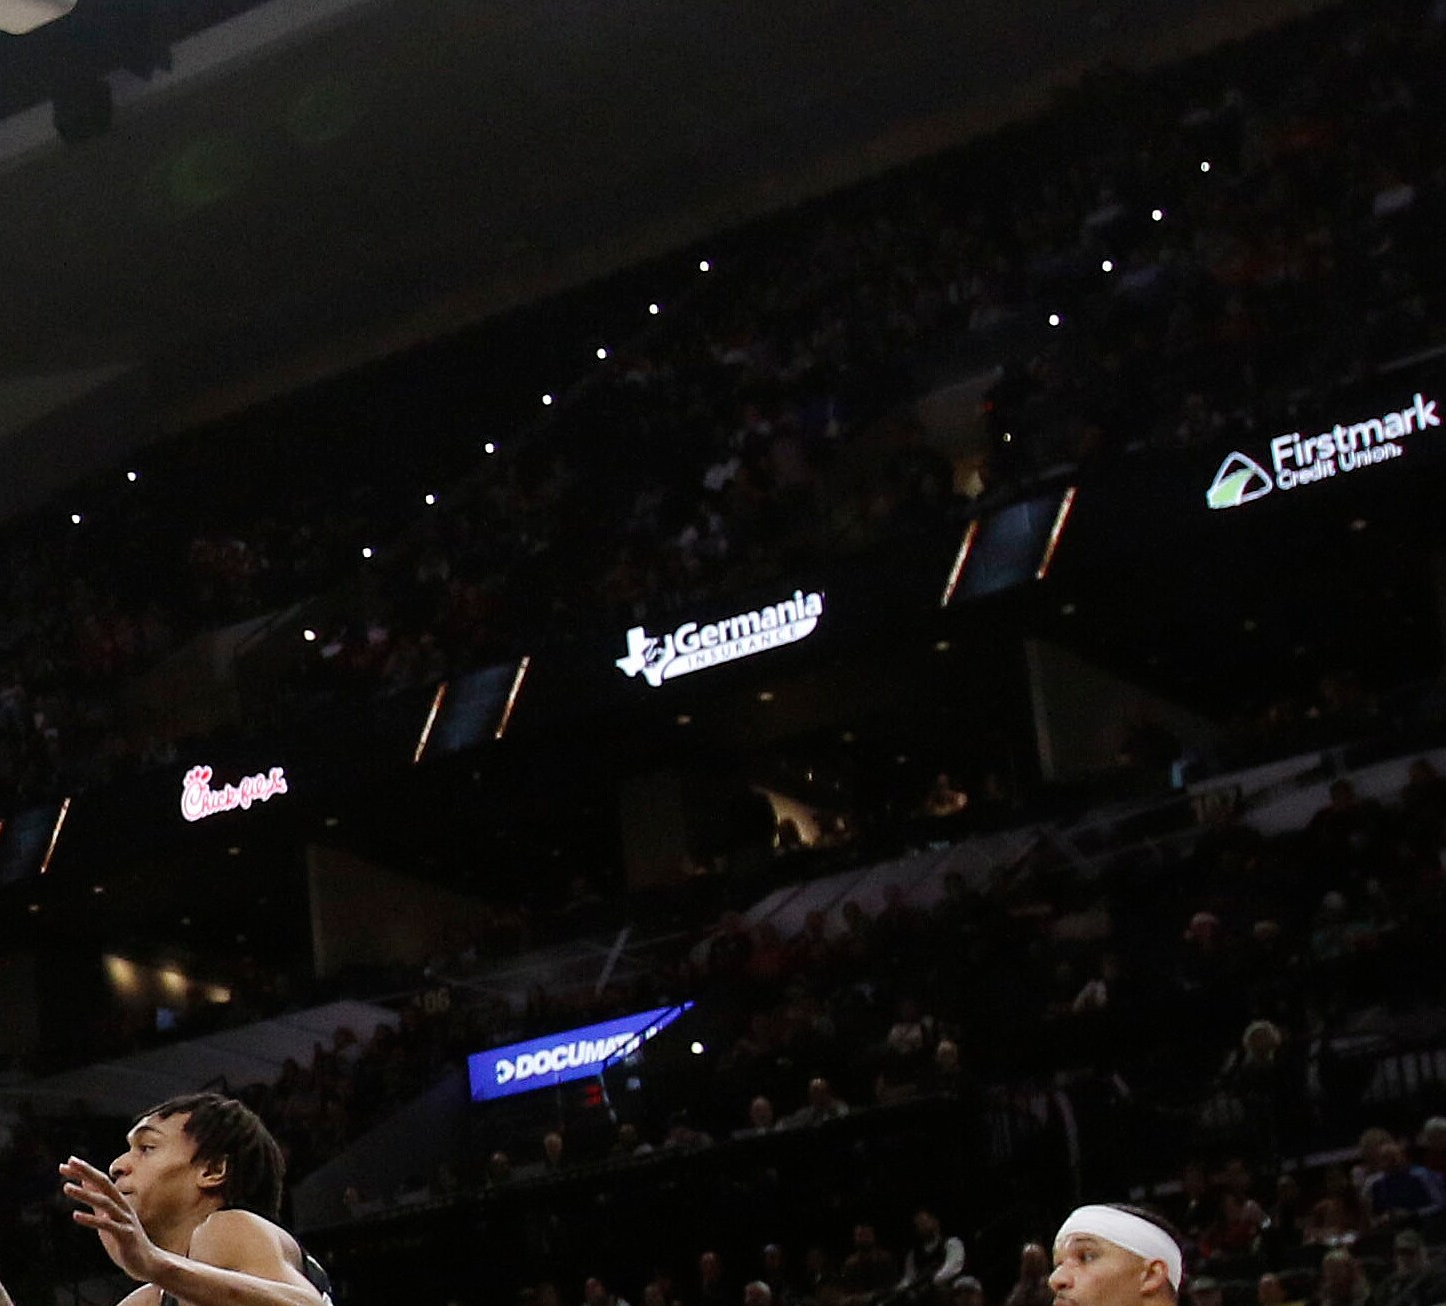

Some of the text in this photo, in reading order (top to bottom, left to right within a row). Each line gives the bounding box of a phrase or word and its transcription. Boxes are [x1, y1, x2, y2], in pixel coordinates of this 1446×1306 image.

[1271, 393, 1441, 472] Firstmark
[1276, 459, 1337, 490] Credit
[674, 590, 824, 654] Germania
[688, 626, 798, 668] INSURANCE
